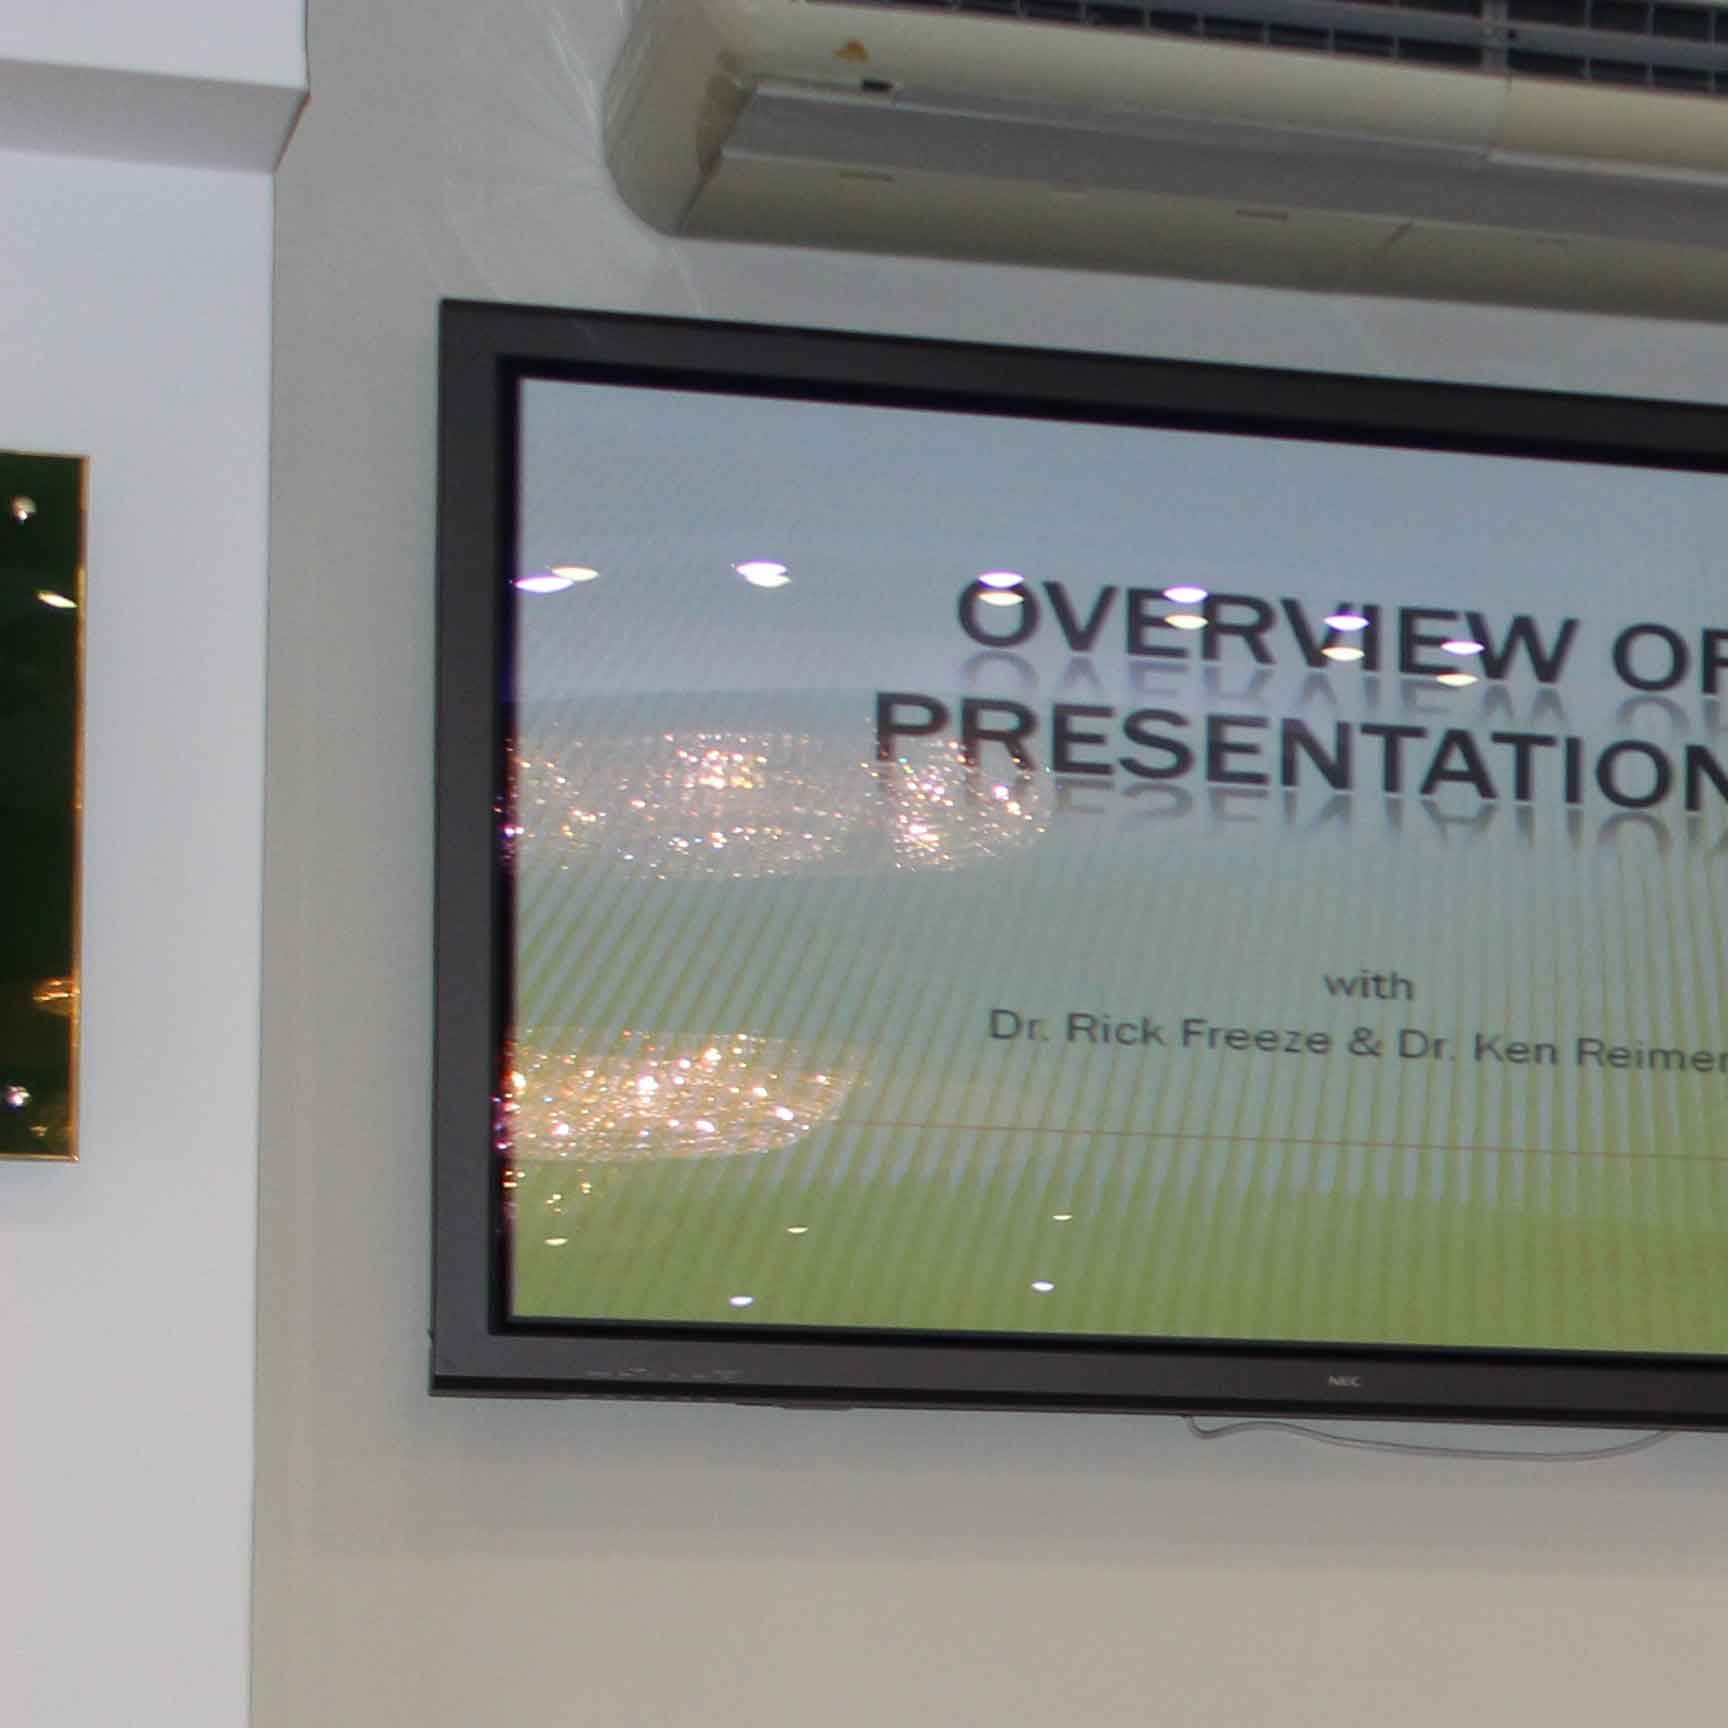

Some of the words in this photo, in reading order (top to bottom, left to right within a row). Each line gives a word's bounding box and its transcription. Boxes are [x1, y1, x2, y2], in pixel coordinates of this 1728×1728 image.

[957, 577, 1580, 684] OVERVIEW
[1324, 970, 1414, 1001] with
[988, 1008, 1048, 1043] Dr.
[1066, 1012, 1165, 1047] Rick
[1183, 1018, 1333, 1054] Freeze
[1348, 1026, 1382, 1058] &
[1400, 1028, 1455, 1061] Dr.
[1475, 1032, 1559, 1066] Ken
